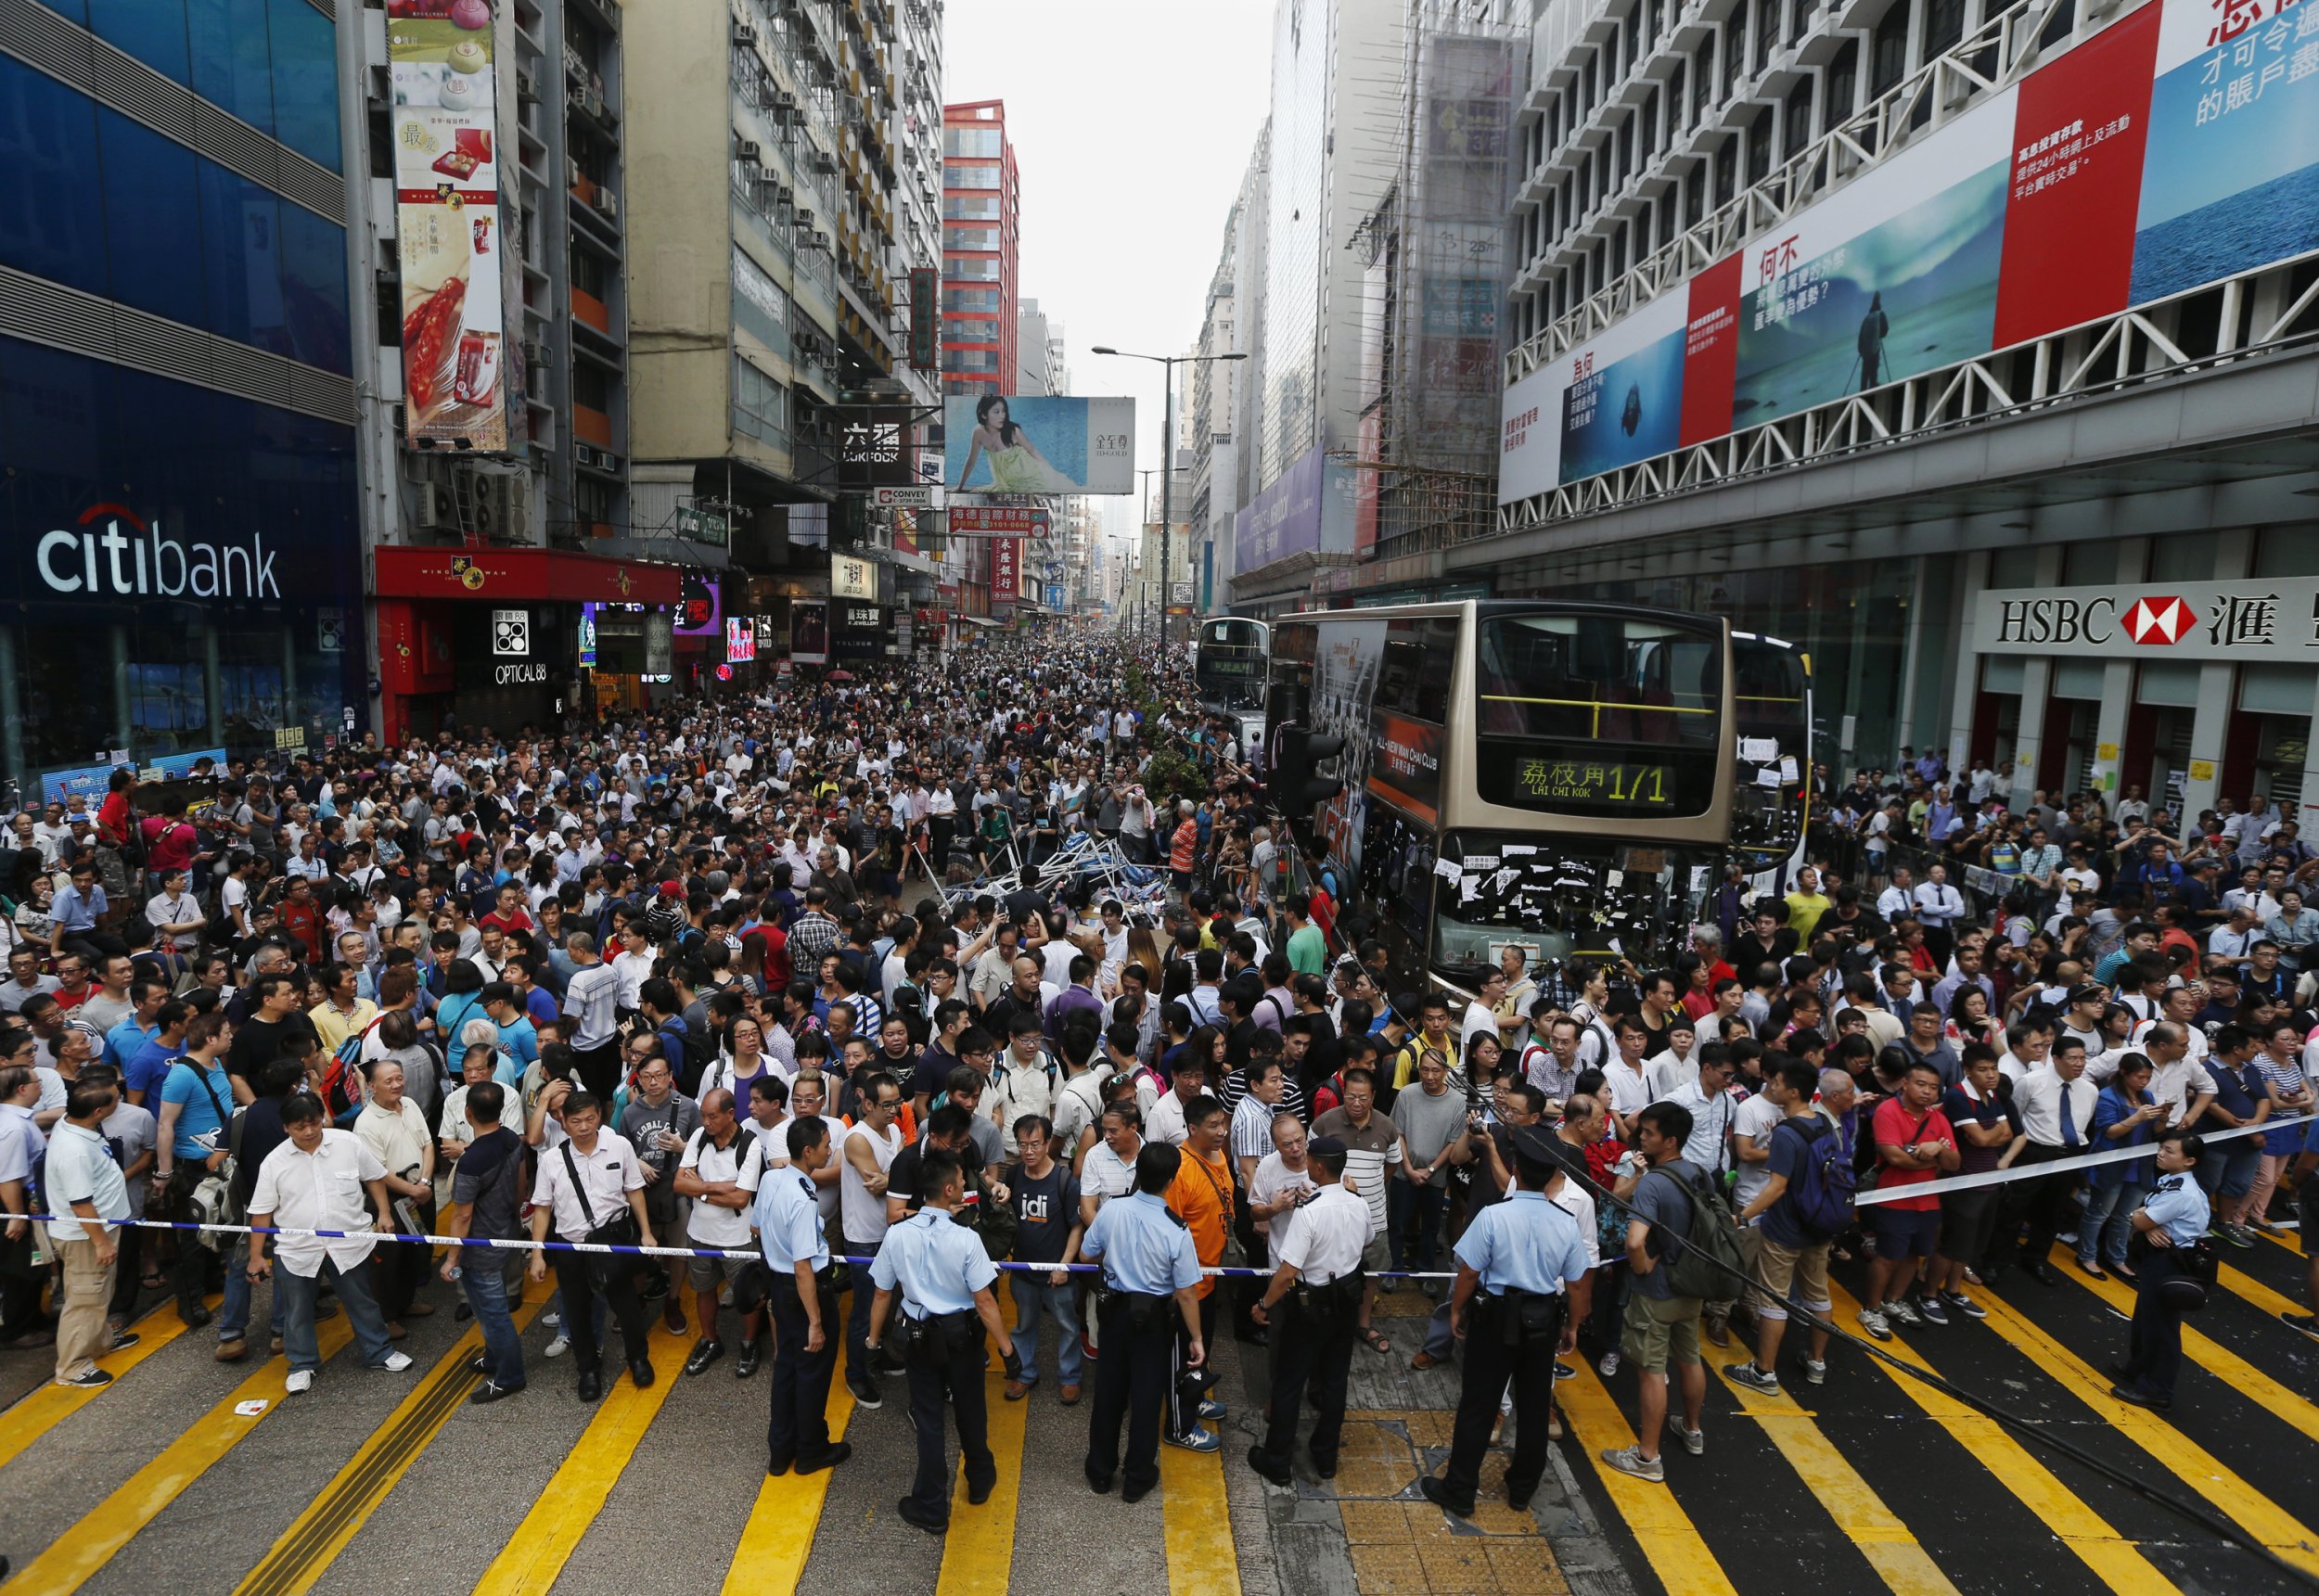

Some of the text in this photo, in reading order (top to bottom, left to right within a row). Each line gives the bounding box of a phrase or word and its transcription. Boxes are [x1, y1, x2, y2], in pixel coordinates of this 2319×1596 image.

[1760, 234, 1800, 287] 何不
[843, 422, 900, 451] 六福
[1095, 434, 1128, 450] 金至尊
[893, 491, 927, 499] CONVEY
[953, 508, 1031, 521] 海德國際財務
[37, 519, 281, 598] citibank
[1001, 538, 1012, 589] 永隆銀行
[515, 612, 526, 620] 88
[1996, 596, 2116, 645] HSBC
[2206, 593, 2319, 647] 滙
[495, 663, 546, 684] OPTICAL 88
[1423, 752, 1438, 771] CLUB
[1521, 759, 1666, 802] 荔枝角 171
[1531, 785, 1591, 798] LAI CHI KOK
[460, 882, 468, 891] 2
[636, 1119, 662, 1142] GLOBAL
[1020, 1193, 1047, 1219] jdi
